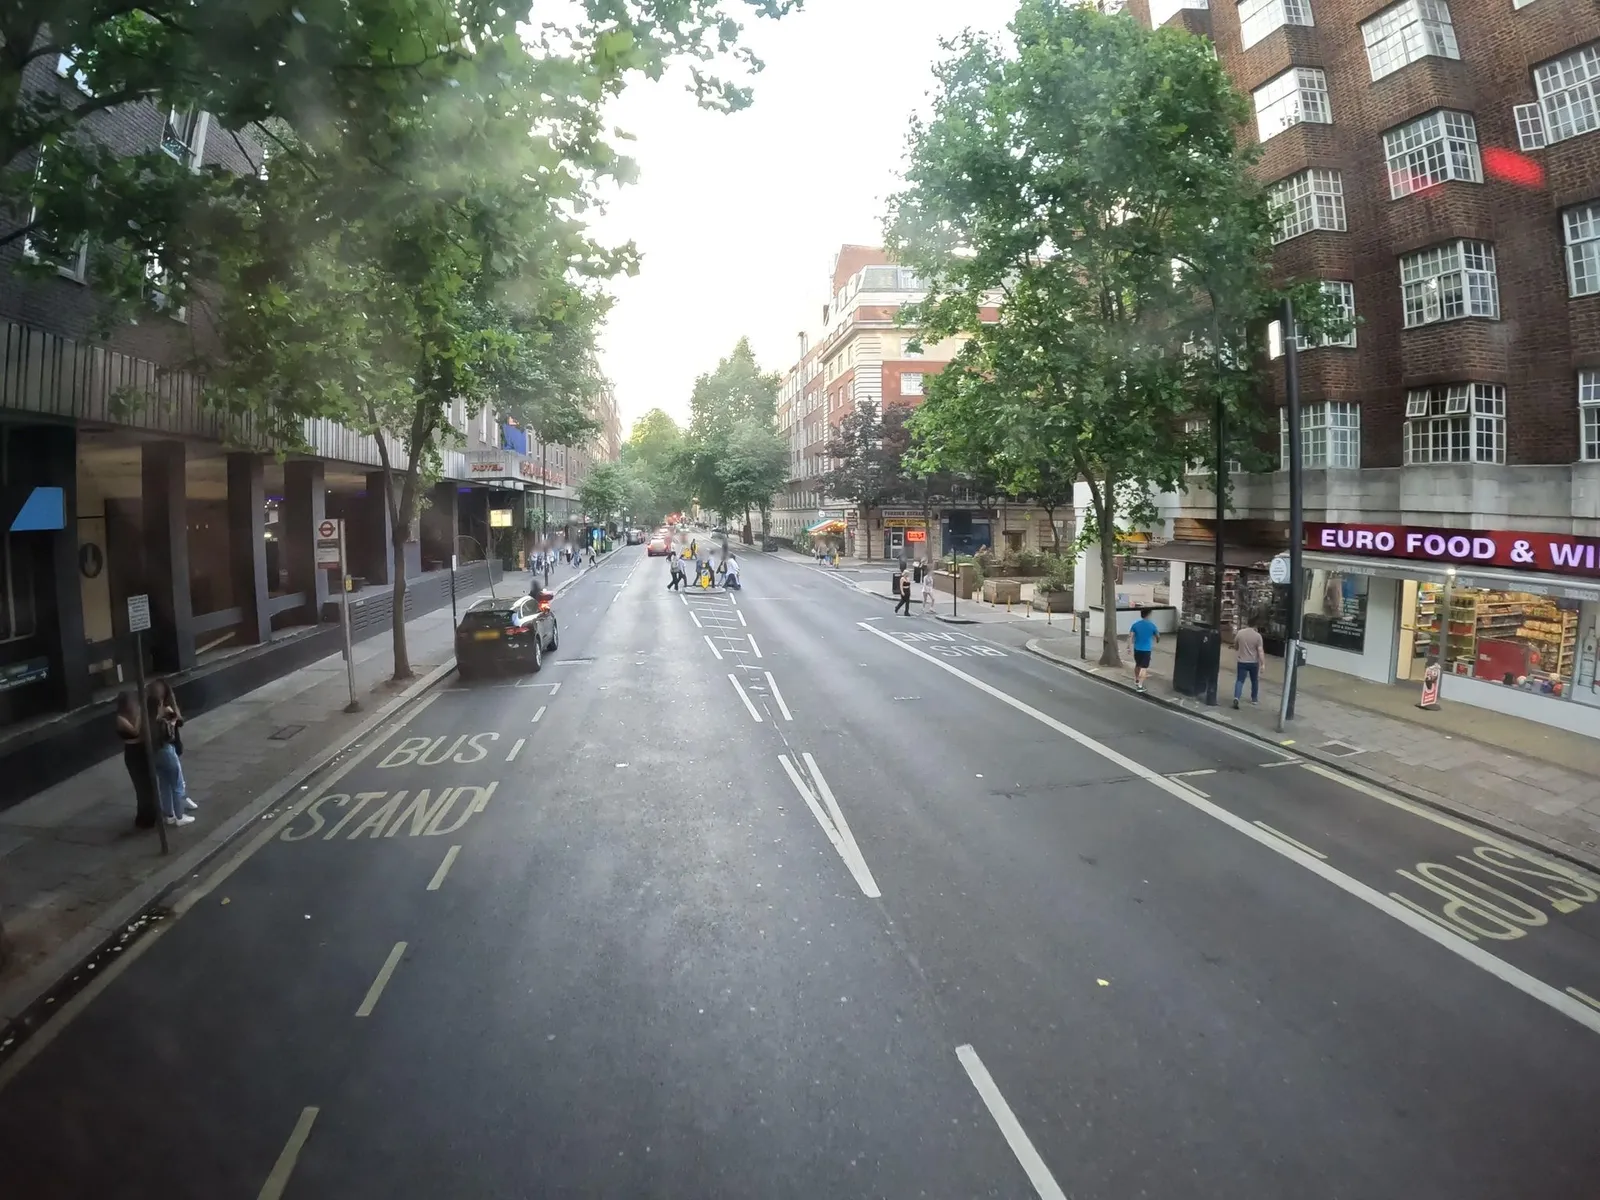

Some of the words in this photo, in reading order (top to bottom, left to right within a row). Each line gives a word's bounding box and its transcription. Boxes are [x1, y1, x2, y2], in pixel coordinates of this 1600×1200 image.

[1321, 529, 1395, 551] EURO
[1406, 533, 1496, 559] FOOD
[1510, 540, 1535, 563] &
[1550, 542, 1600, 569] WI
[889, 631, 979, 642] LANE
[930, 645, 1009, 657] BUS
[376, 732, 500, 768] BUS
[279, 785, 485, 842] STAND
